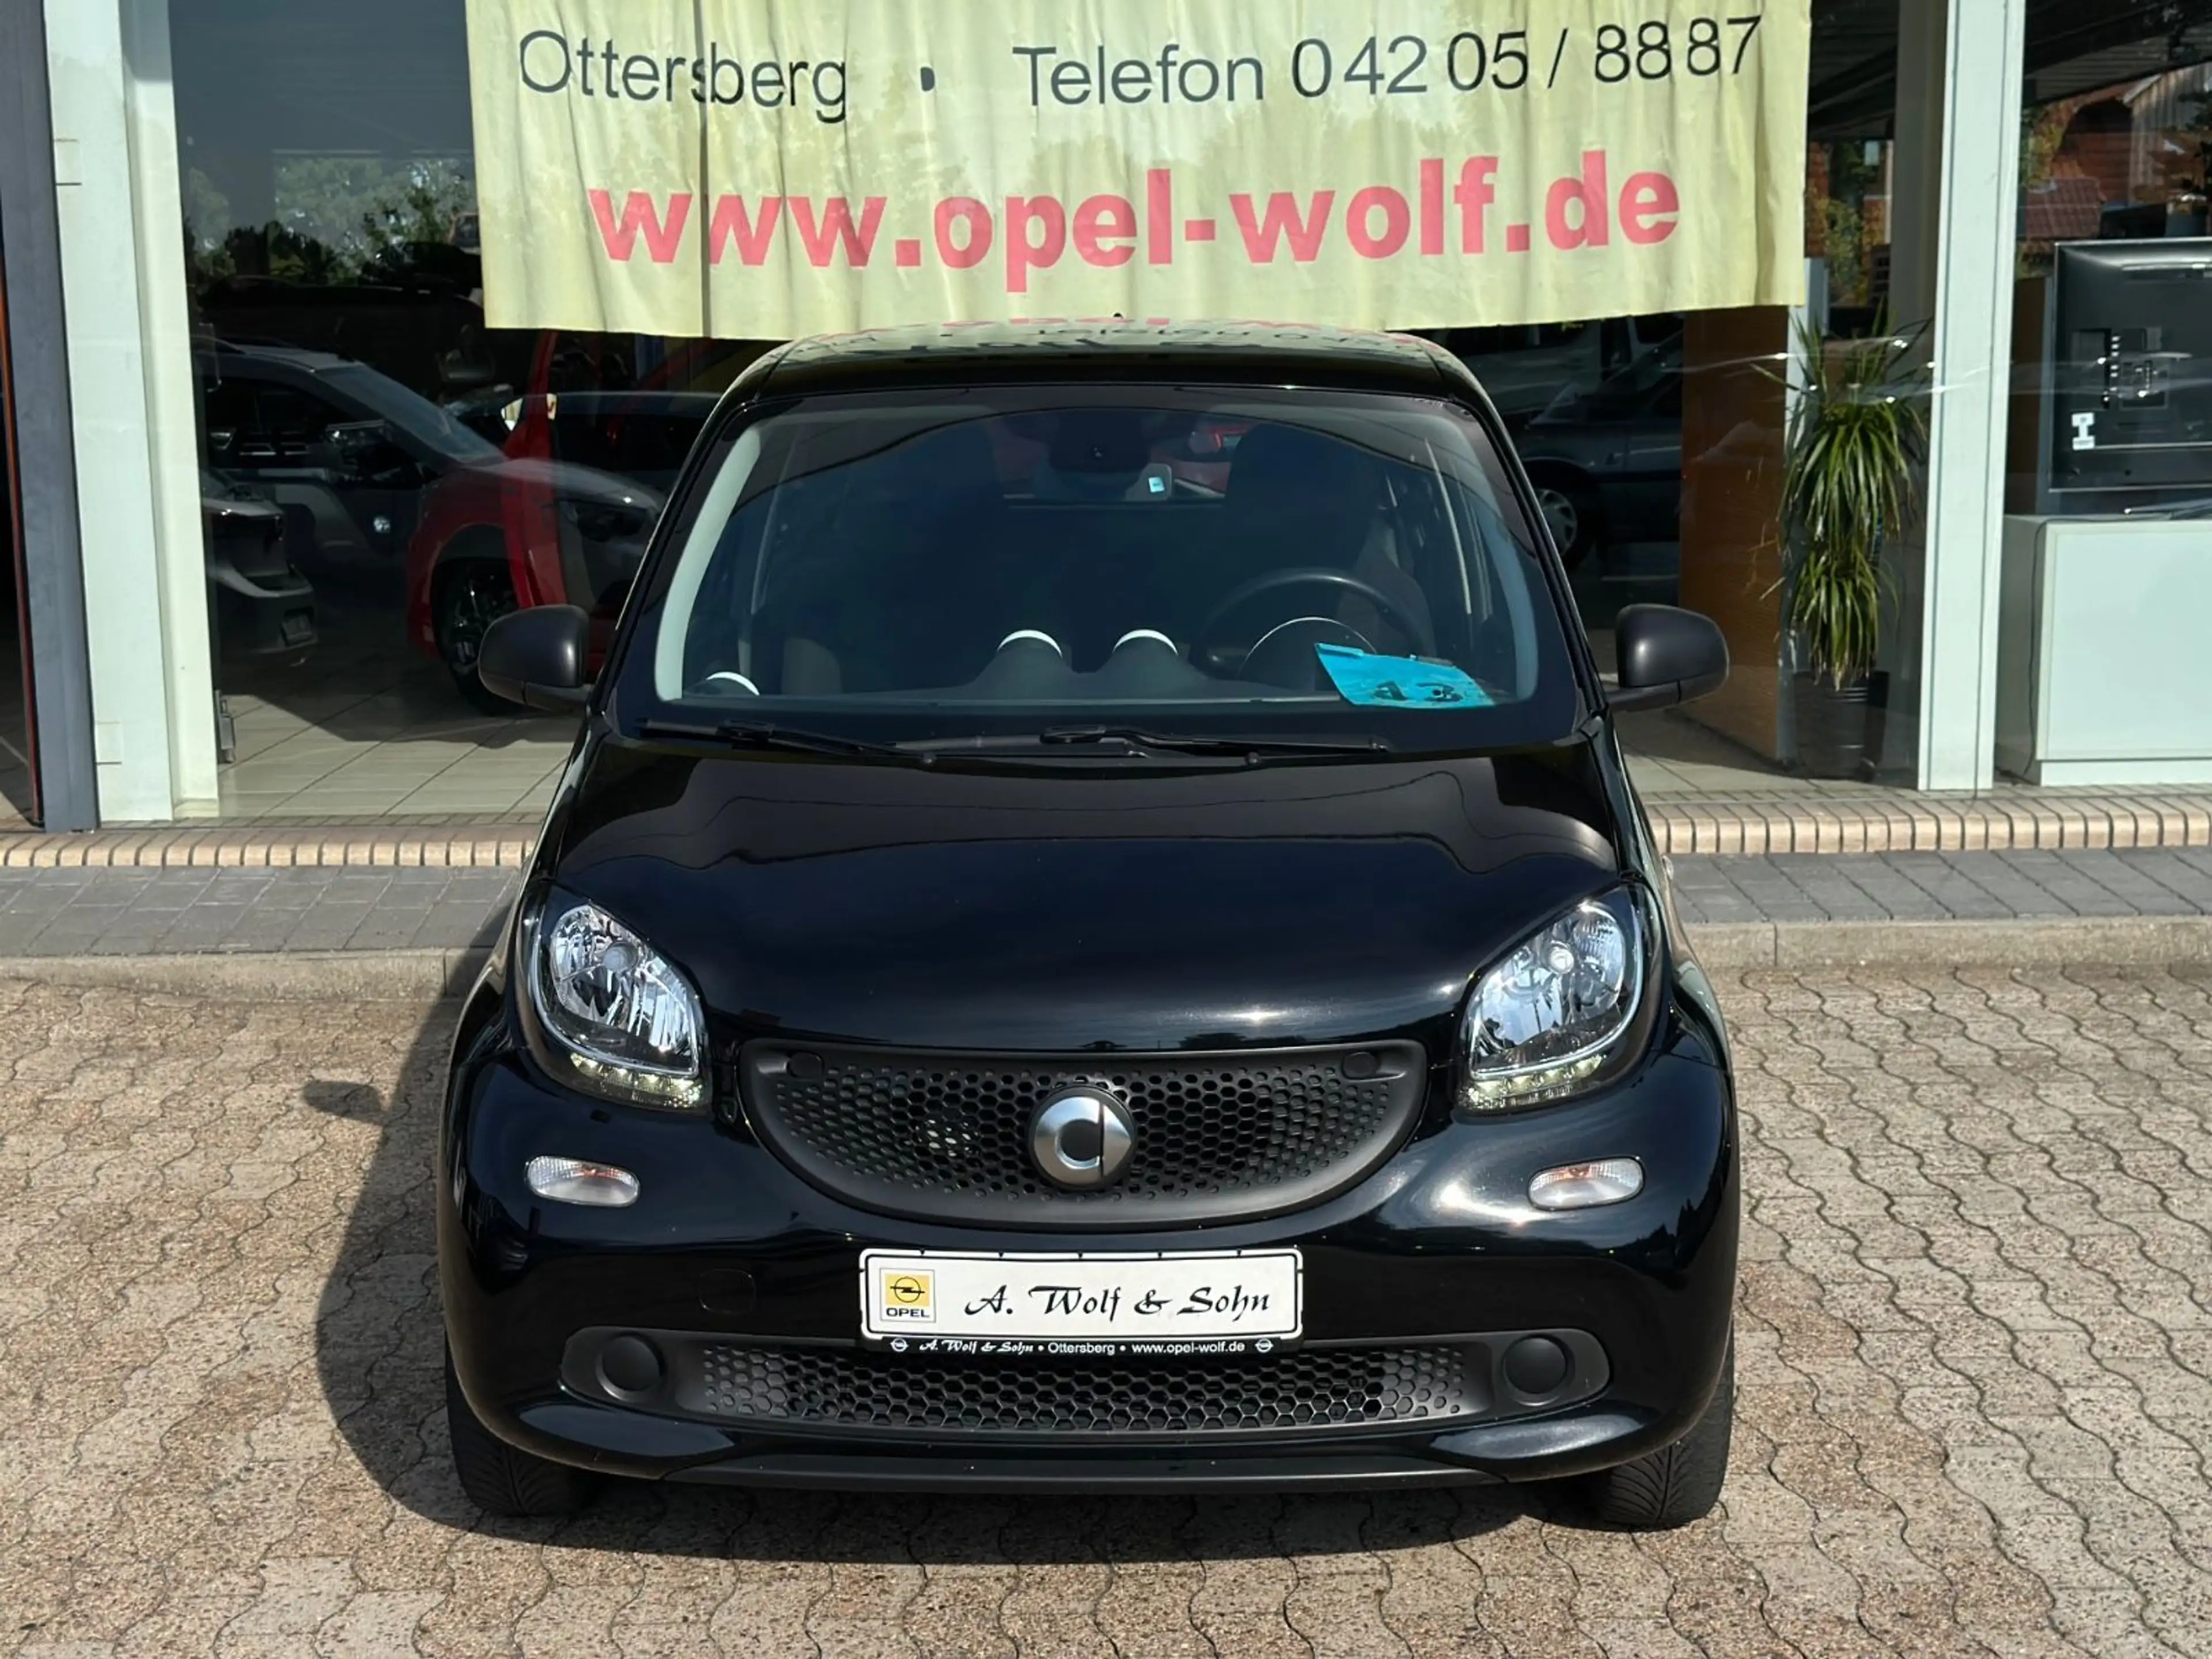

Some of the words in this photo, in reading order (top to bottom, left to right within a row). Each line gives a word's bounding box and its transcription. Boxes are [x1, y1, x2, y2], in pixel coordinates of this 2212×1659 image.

[520, 30, 847, 123] Ottersberg
[1013, 46, 1265, 107] Telefon
[588, 149, 1680, 293] www.opel-wolf.de
[885, 1308, 930, 1318] OPEL
[964, 1285, 1014, 1316] A.
[1028, 1285, 1122, 1321] Wolf
[1134, 1289, 1173, 1316] &
[1176, 1285, 1271, 1321] Sohn
[942, 1339, 978, 1354] Wolf
[999, 1340, 1035, 1354] Sohn
[1048, 1342, 1116, 1356] Ottersberg
[1131, 1341, 1246, 1356] www.opel-wolf.de
